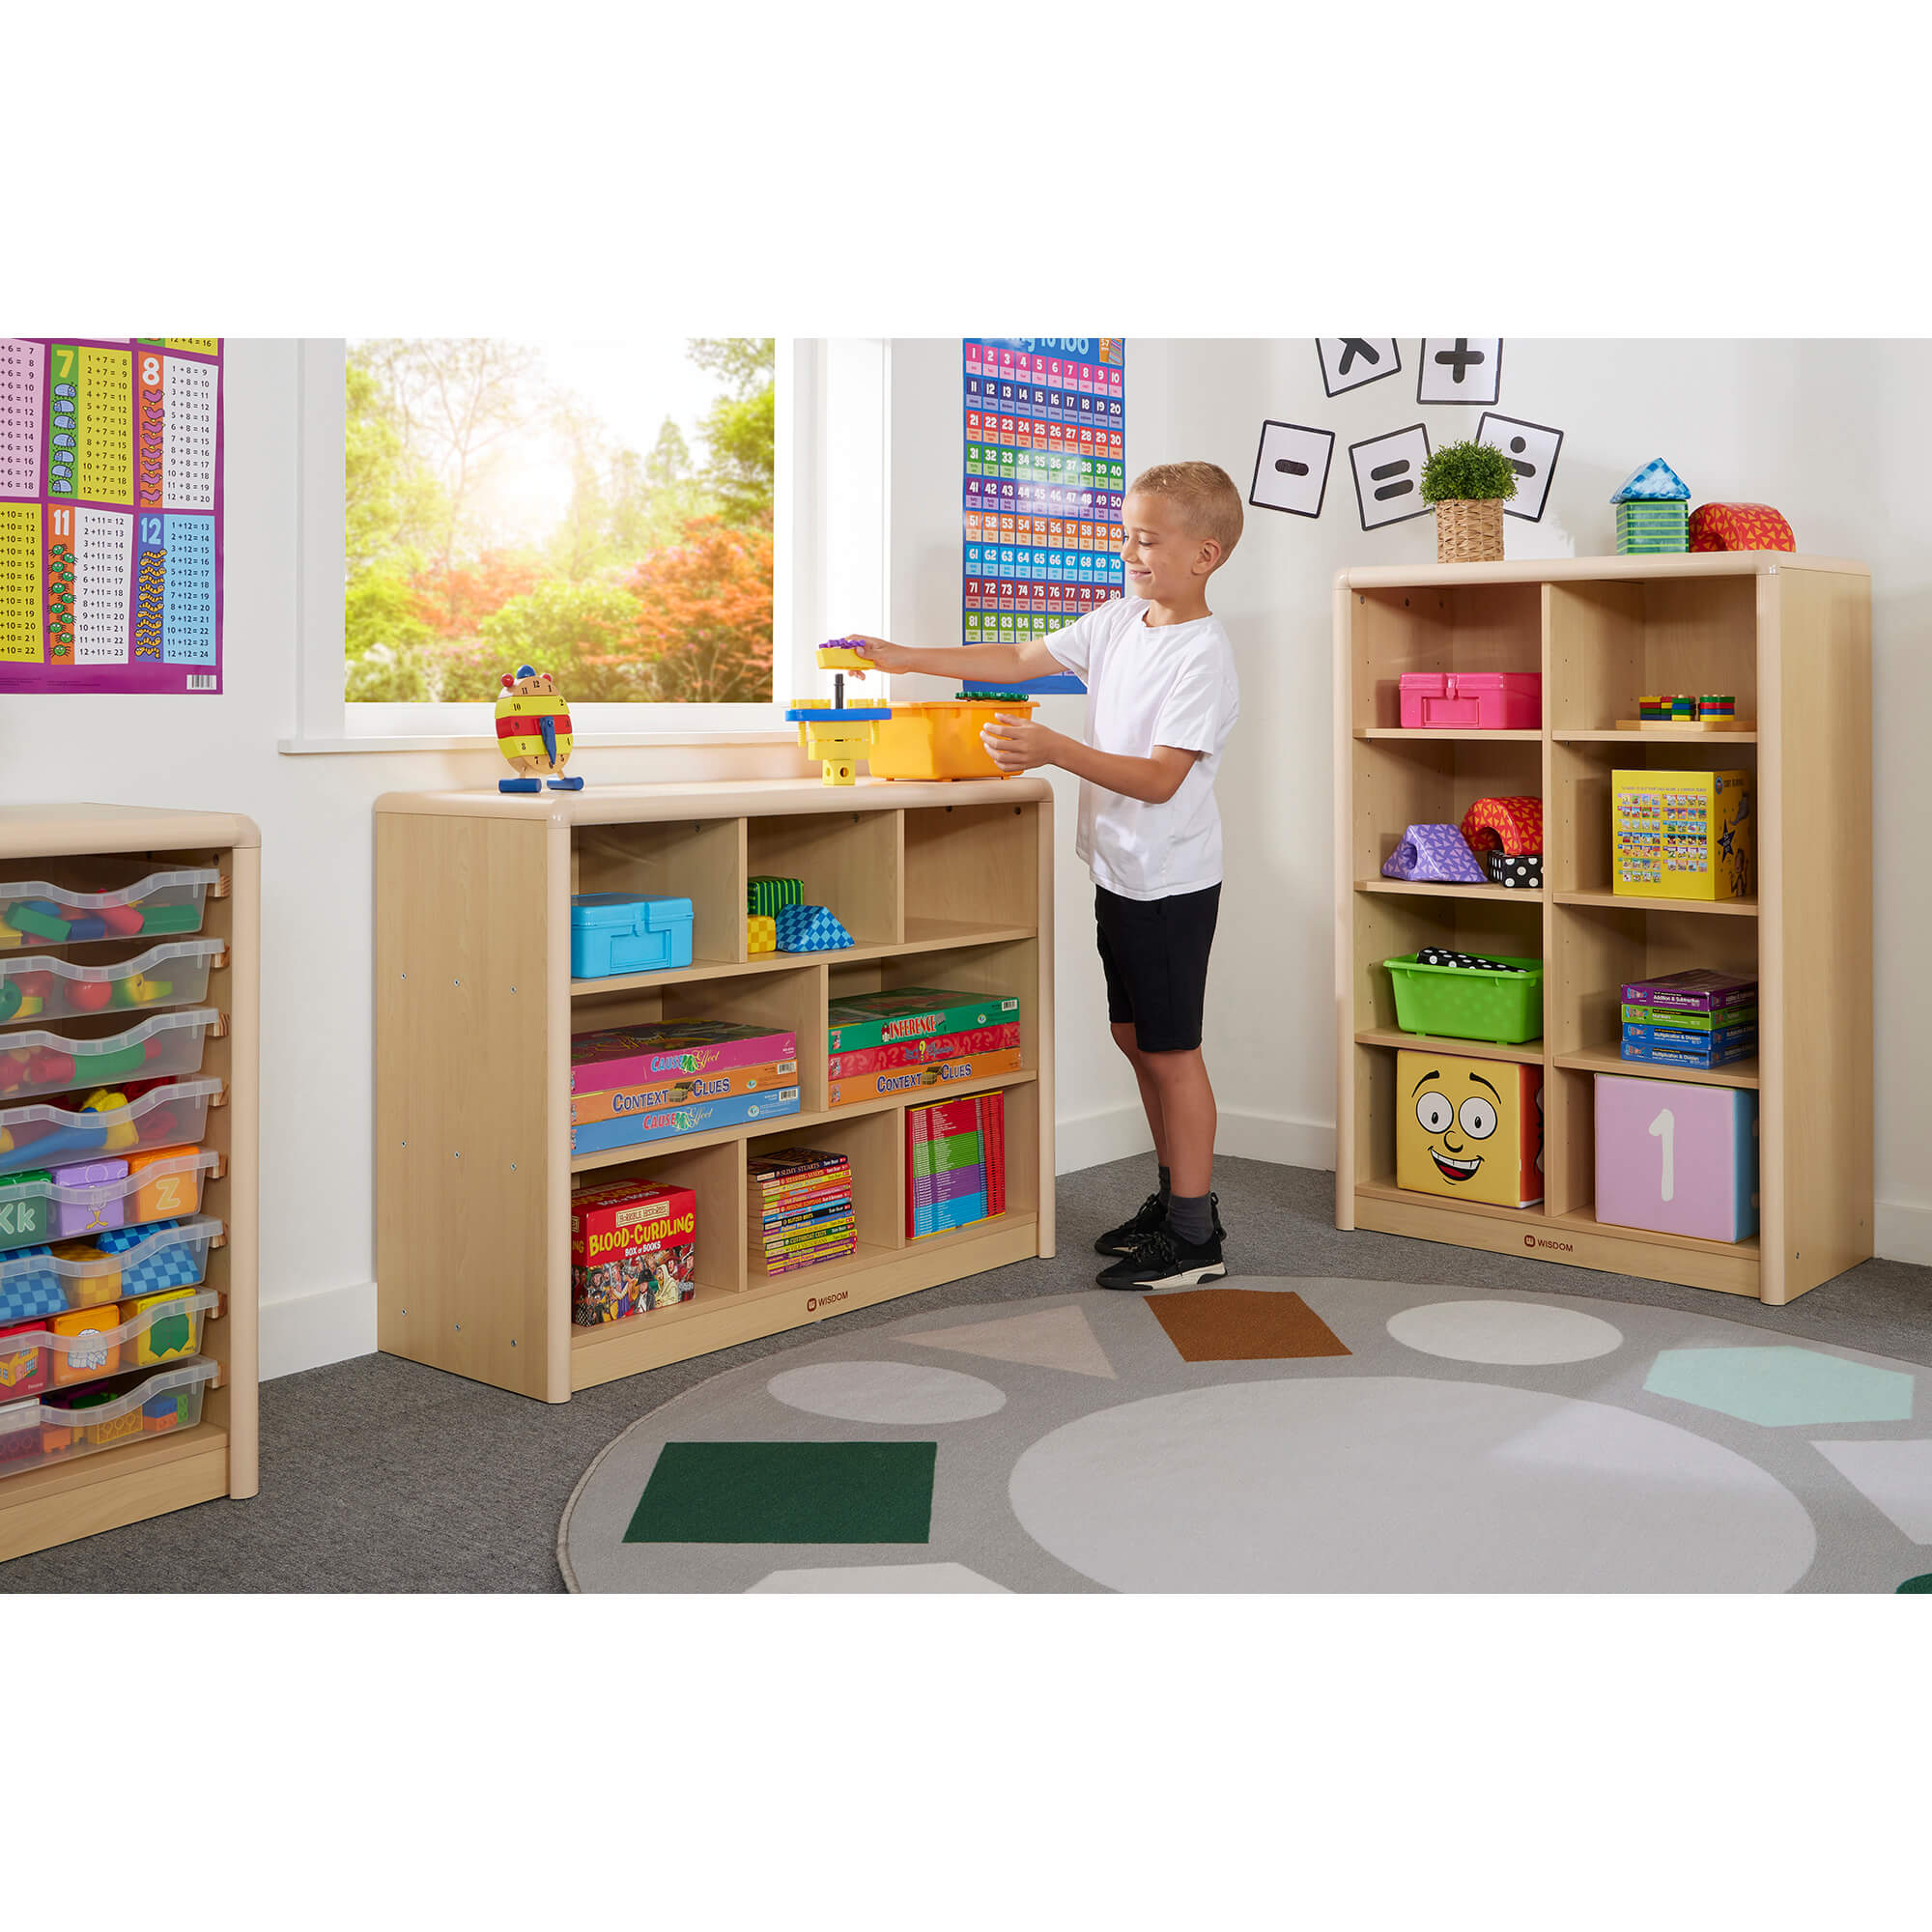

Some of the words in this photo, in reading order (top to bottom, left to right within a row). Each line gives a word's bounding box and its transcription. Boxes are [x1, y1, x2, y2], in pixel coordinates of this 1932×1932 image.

[57, 350, 73, 378] 7
[142, 357, 160, 386] 8
[988, 350, 994, 362] 2
[1004, 353, 1010, 365] 3
[1020, 356, 1027, 367] 4
[1037, 359, 1043, 370] 5
[1052, 362, 1058, 373] 6
[1067, 364, 1073, 375] 7
[1083, 367, 1089, 378] 8
[1098, 370, 1104, 380] 9
[1111, 372, 1120, 384] 10
[971, 381, 977, 392] 11
[986, 383, 995, 395] 12
[1003, 386, 1011, 398] 13
[1019, 388, 1028, 400] 14
[1035, 391, 1044, 403] 15
[1051, 394, 1059, 405] 16
[1066, 396, 1074, 407] 17
[1082, 398, 1090, 410] 18
[1097, 401, 1105, 412] 19
[1110, 403, 1121, 415] 20
[970, 414, 979, 426] 21
[985, 416, 997, 428] 22
[1002, 418, 1013, 431] 23
[1018, 420, 1029, 433] 24
[1034, 423, 1046, 435] 25
[1050, 425, 1061, 437] 26
[1066, 427, 1076, 439] 27
[1081, 430, 1092, 441] 28
[1096, 432, 1107, 443] 29
[1110, 434, 1121, 446] 30
[970, 448, 979, 459] 31
[985, 449, 997, 461] 32
[1002, 451, 1013, 464] 33
[1096, 463, 1107, 474] 39
[1110, 465, 1122, 477] 40
[969, 481, 979, 493] 41
[985, 483, 997, 495] 42
[1001, 485, 1013, 496] 43
[1096, 495, 1107, 506] 49
[1111, 496, 1122, 507] 50
[54, 510, 70, 536] 11
[141, 517, 162, 545] 12
[1002, 517, 1014, 529] 53
[1018, 519, 1030, 531] 54
[1034, 519, 1046, 533] 55
[1050, 521, 1061, 534] 56
[1066, 523, 1077, 534] 57
[1081, 524, 1092, 536] 58
[1096, 526, 1107, 537] 59
[1110, 527, 1122, 539] 60
[969, 548, 978, 560] 61
[984, 549, 997, 561] 62
[1001, 550, 1013, 562] 63
[1017, 552, 1029, 563] 64
[1034, 553, 1045, 565] 65
[1049, 554, 1061, 566] 66
[1065, 555, 1076, 566] 67
[1080, 556, 1091, 568] 68
[1095, 557, 1107, 568] 69
[1110, 559, 1121, 570] 70
[969, 582, 978, 593] 71
[985, 582, 996, 594] 72
[1001, 583, 1012, 595] 73
[1018, 585, 1028, 596] 74
[1033, 585, 1044, 597] 75
[1049, 587, 1060, 597] 76
[1065, 587, 1075, 598] 77
[1080, 588, 1091, 599] 78
[1095, 589, 1106, 599] 79
[1109, 589, 1121, 601] 80
[969, 615, 978, 627] 81
[984, 616, 996, 627] 82
[1001, 616, 1013, 628] 83
[1017, 617, 1029, 628] 84
[1033, 618, 1045, 629] 85
[1049, 618, 1060, 630] 86
[889, 1015, 936, 1039] INFERENCE
[651, 1054, 683, 1072] CAUSE
[877, 1072, 922, 1094] CONTEXT
[941, 1064, 972, 1081] CLUES
[612, 1089, 669, 1113] CONTEXT
[693, 1078, 730, 1098] CLUES
[643, 1112, 677, 1131] CAUSE
[1648, 1108, 1675, 1201] 1
[589, 1213, 694, 1257] BLOOD-CURDLING
[1537, 1239, 1573, 1252] WISDOM
[625, 1247, 637, 1257] BOX
[643, 1241, 661, 1253] BOOKS
[818, 1290, 848, 1306] WISDOM
